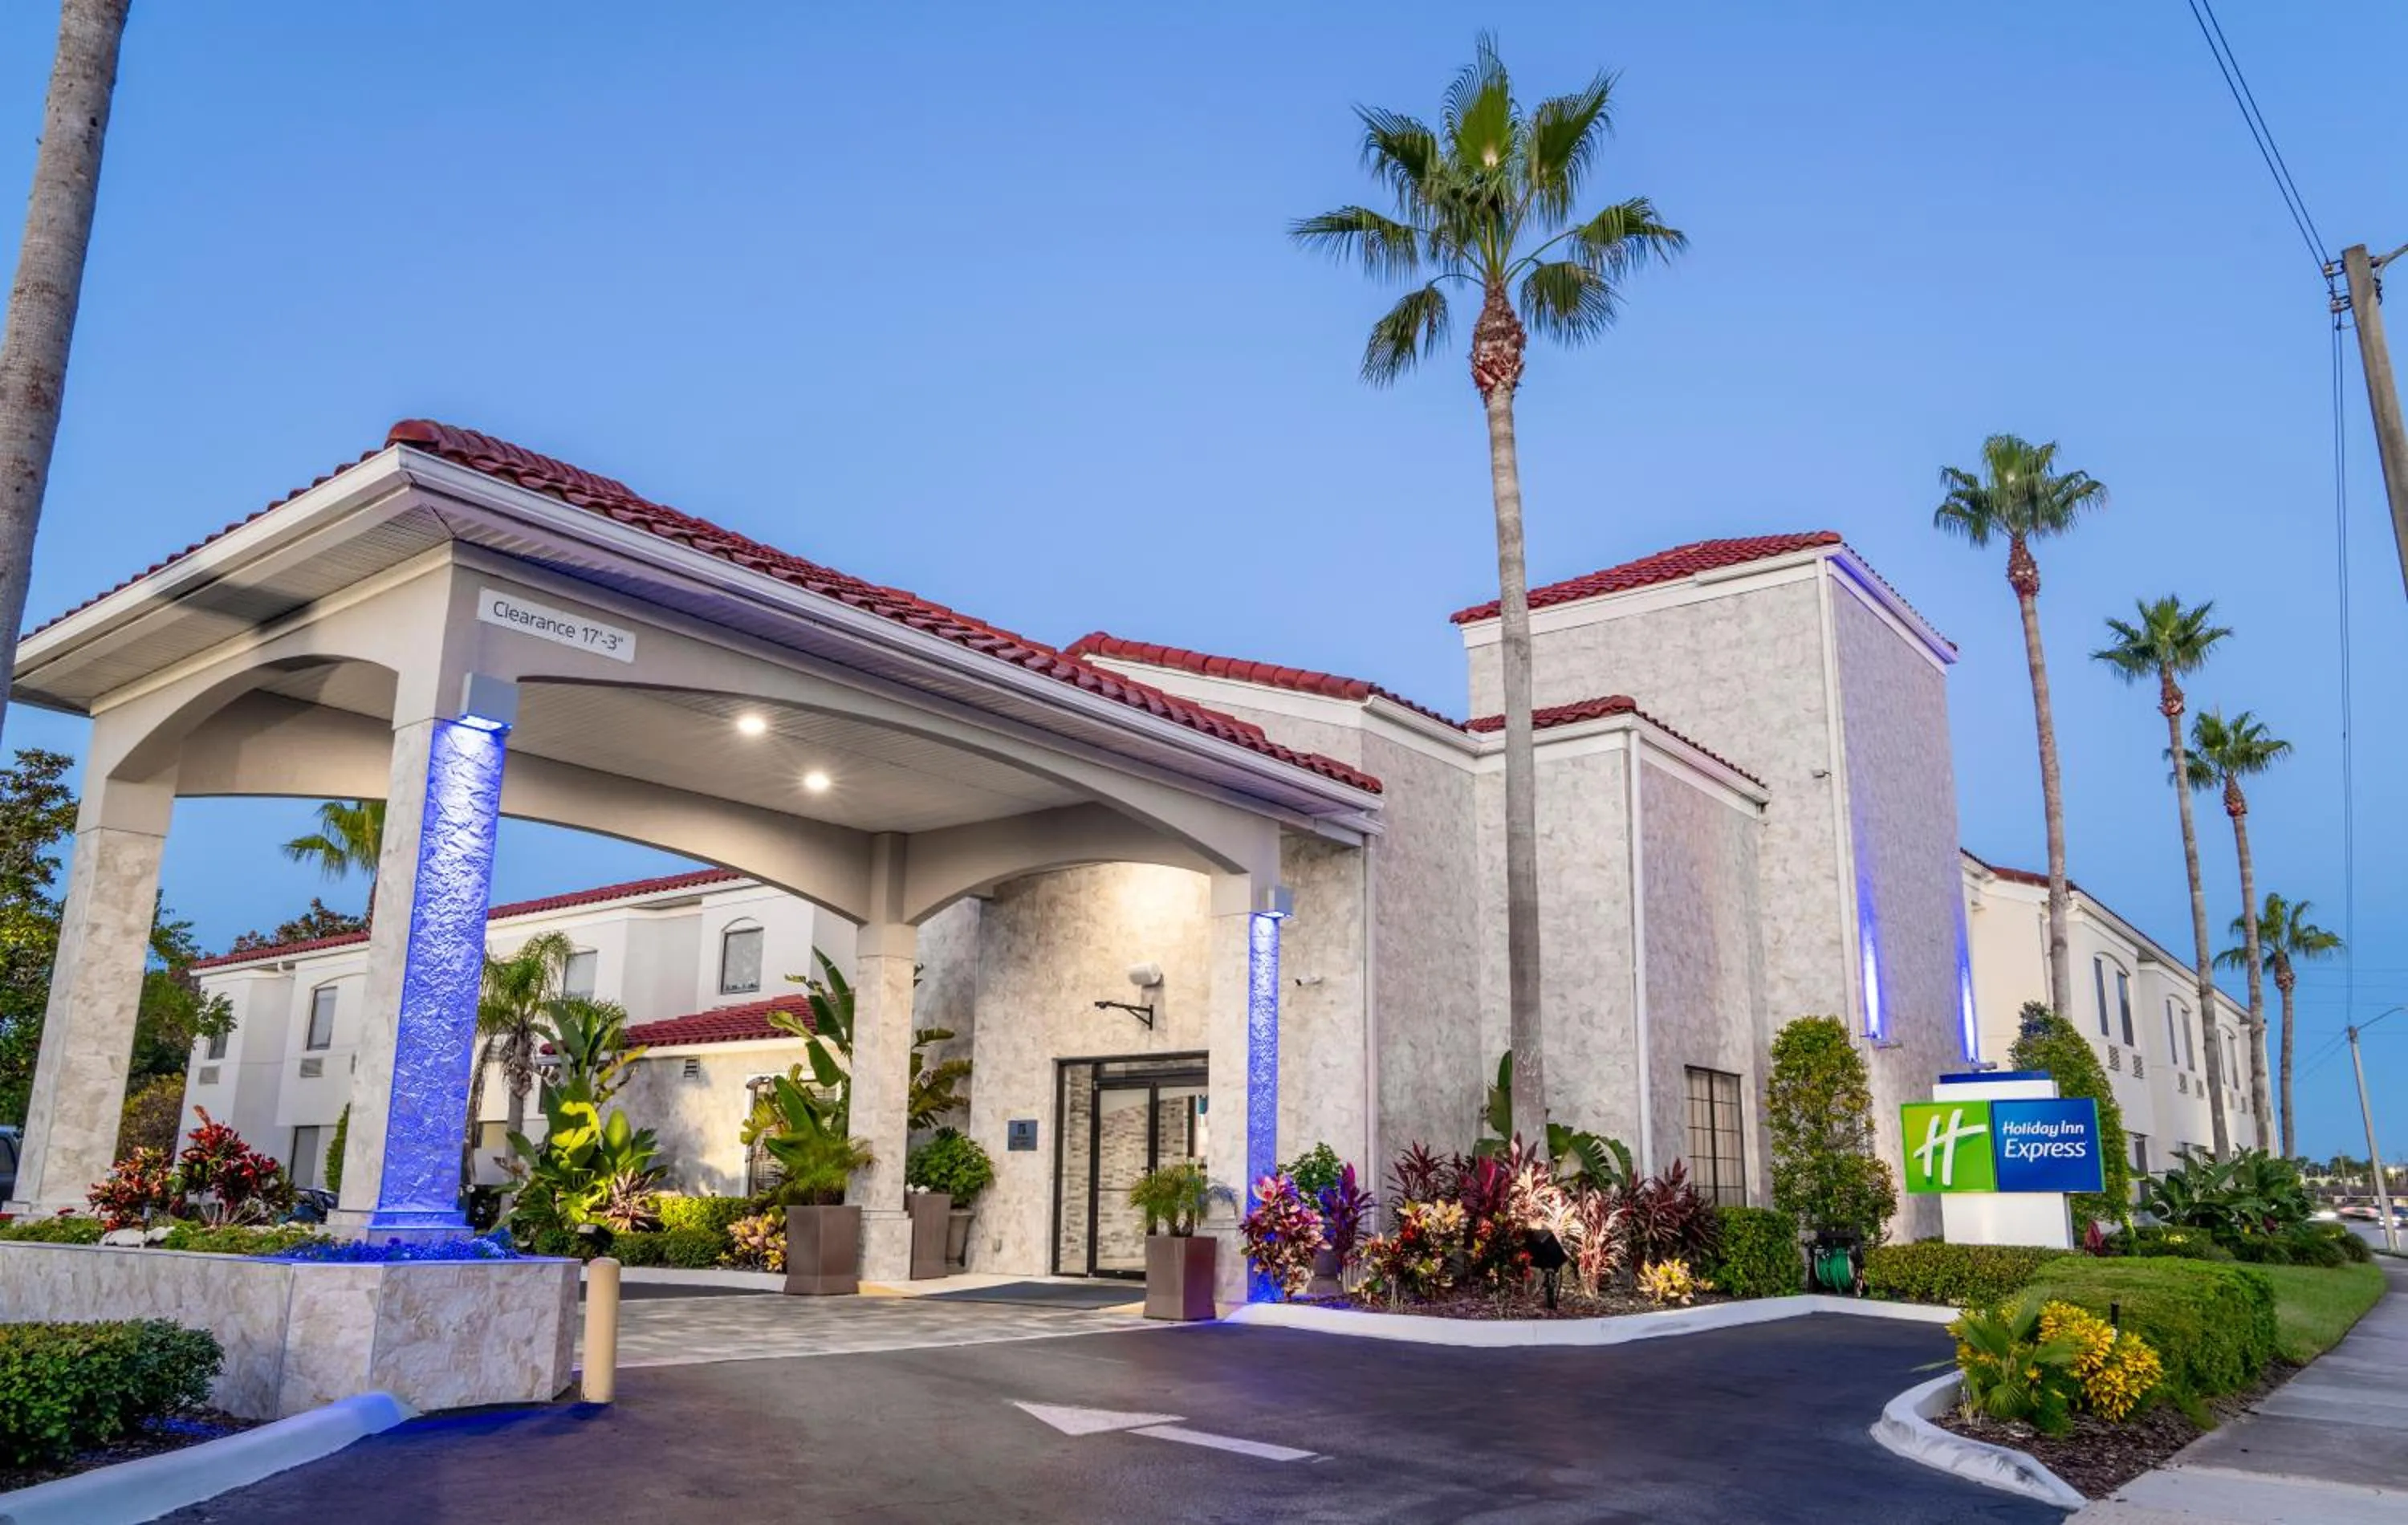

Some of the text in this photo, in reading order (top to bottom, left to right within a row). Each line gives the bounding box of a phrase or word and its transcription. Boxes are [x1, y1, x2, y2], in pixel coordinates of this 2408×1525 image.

[493, 600, 576, 639] Clearance
[2003, 1120, 2085, 1138] Holiday Inn
[2004, 1138, 2087, 1162] Express
